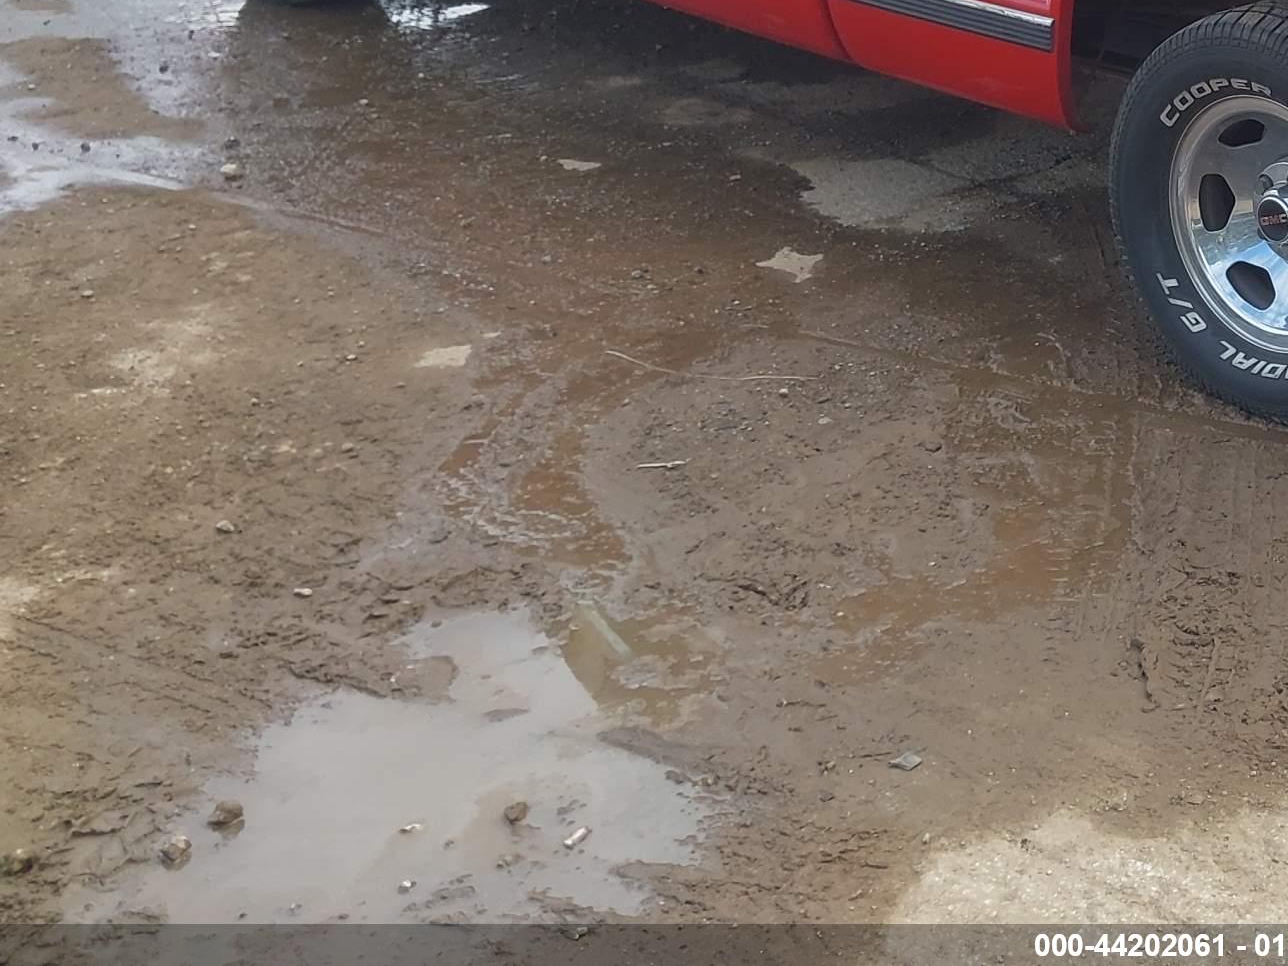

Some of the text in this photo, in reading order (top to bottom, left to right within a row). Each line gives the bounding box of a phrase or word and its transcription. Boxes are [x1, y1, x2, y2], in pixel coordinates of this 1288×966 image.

[1160, 77, 1272, 127] COOPER
[1260, 213, 1288, 226] GMC
[1155, 272, 1208, 334] G/T
